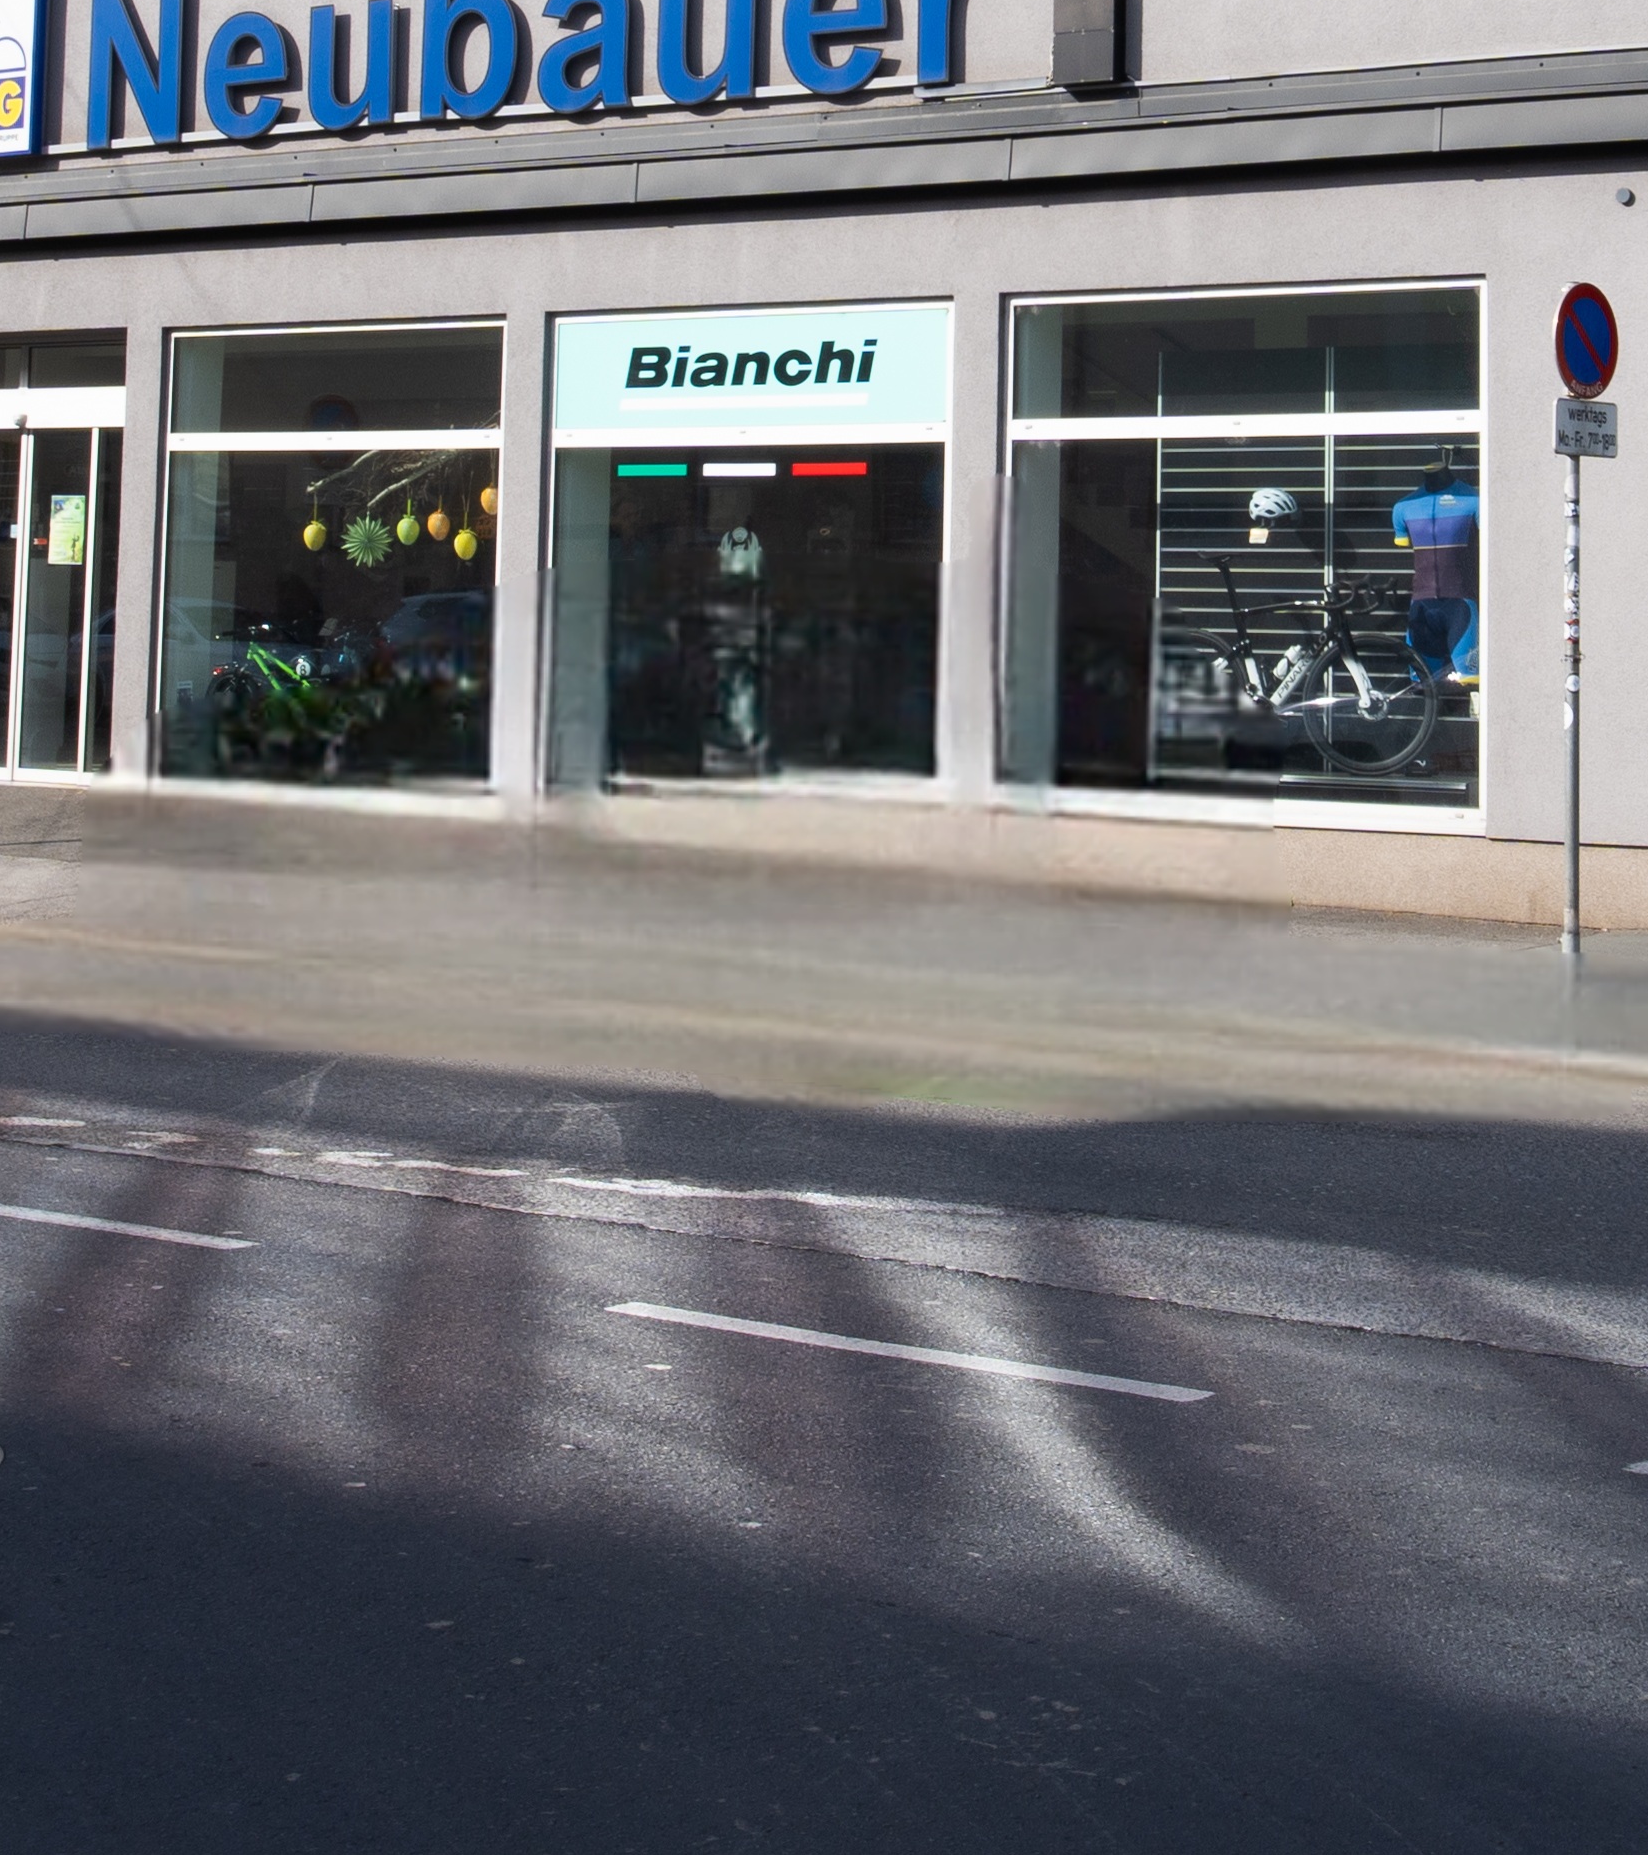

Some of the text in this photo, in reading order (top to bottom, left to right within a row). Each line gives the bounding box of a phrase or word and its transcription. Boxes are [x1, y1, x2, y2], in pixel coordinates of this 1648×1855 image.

[625, 339, 878, 388] Bianchi
[1571, 379, 1604, 397] ANFANG
[1568, 406, 1608, 428] werktags
